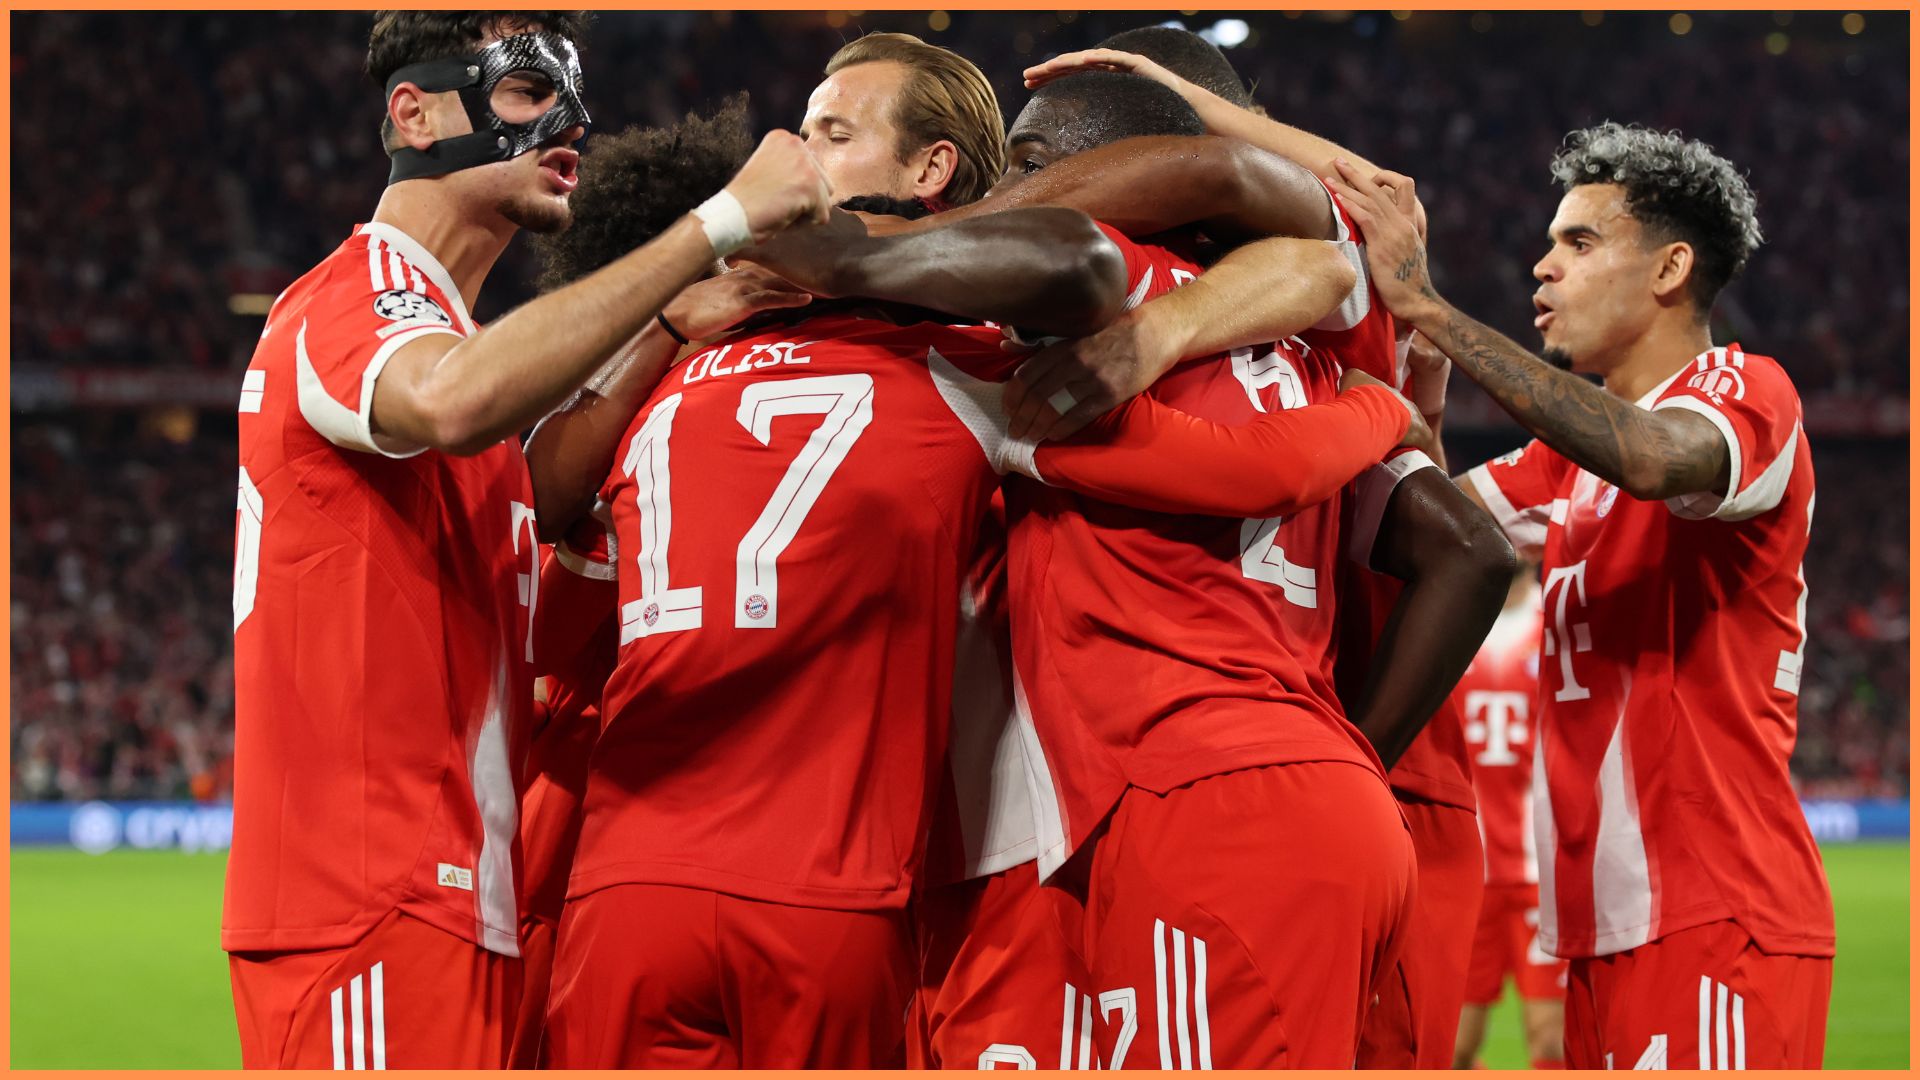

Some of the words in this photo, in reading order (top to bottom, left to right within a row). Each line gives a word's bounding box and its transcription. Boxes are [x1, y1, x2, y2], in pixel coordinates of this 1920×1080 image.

[620, 373, 874, 646] 17
[1542, 560, 1593, 702] T
[1464, 689, 1530, 767] T
